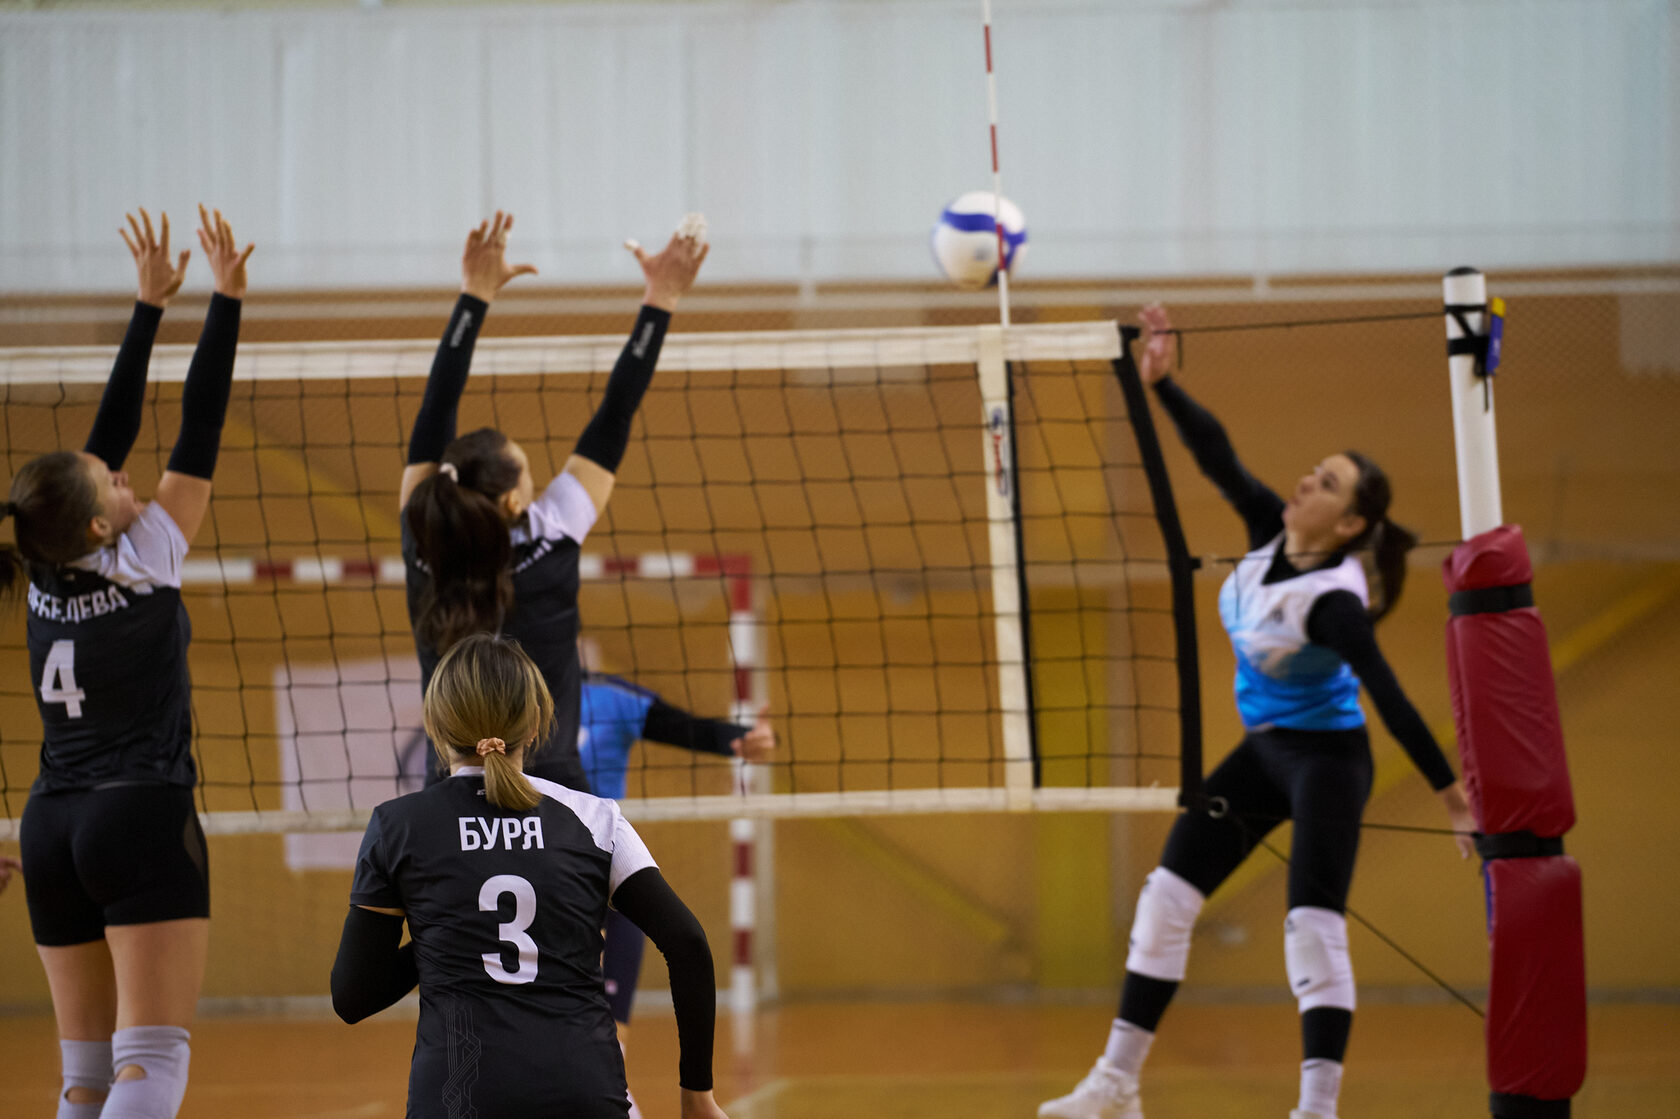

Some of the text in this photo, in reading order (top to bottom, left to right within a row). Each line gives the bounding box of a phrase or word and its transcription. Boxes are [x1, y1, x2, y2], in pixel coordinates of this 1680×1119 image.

[40, 639, 86, 719] 4
[458, 816, 545, 851] БУРЯ
[478, 874, 539, 985] 3
